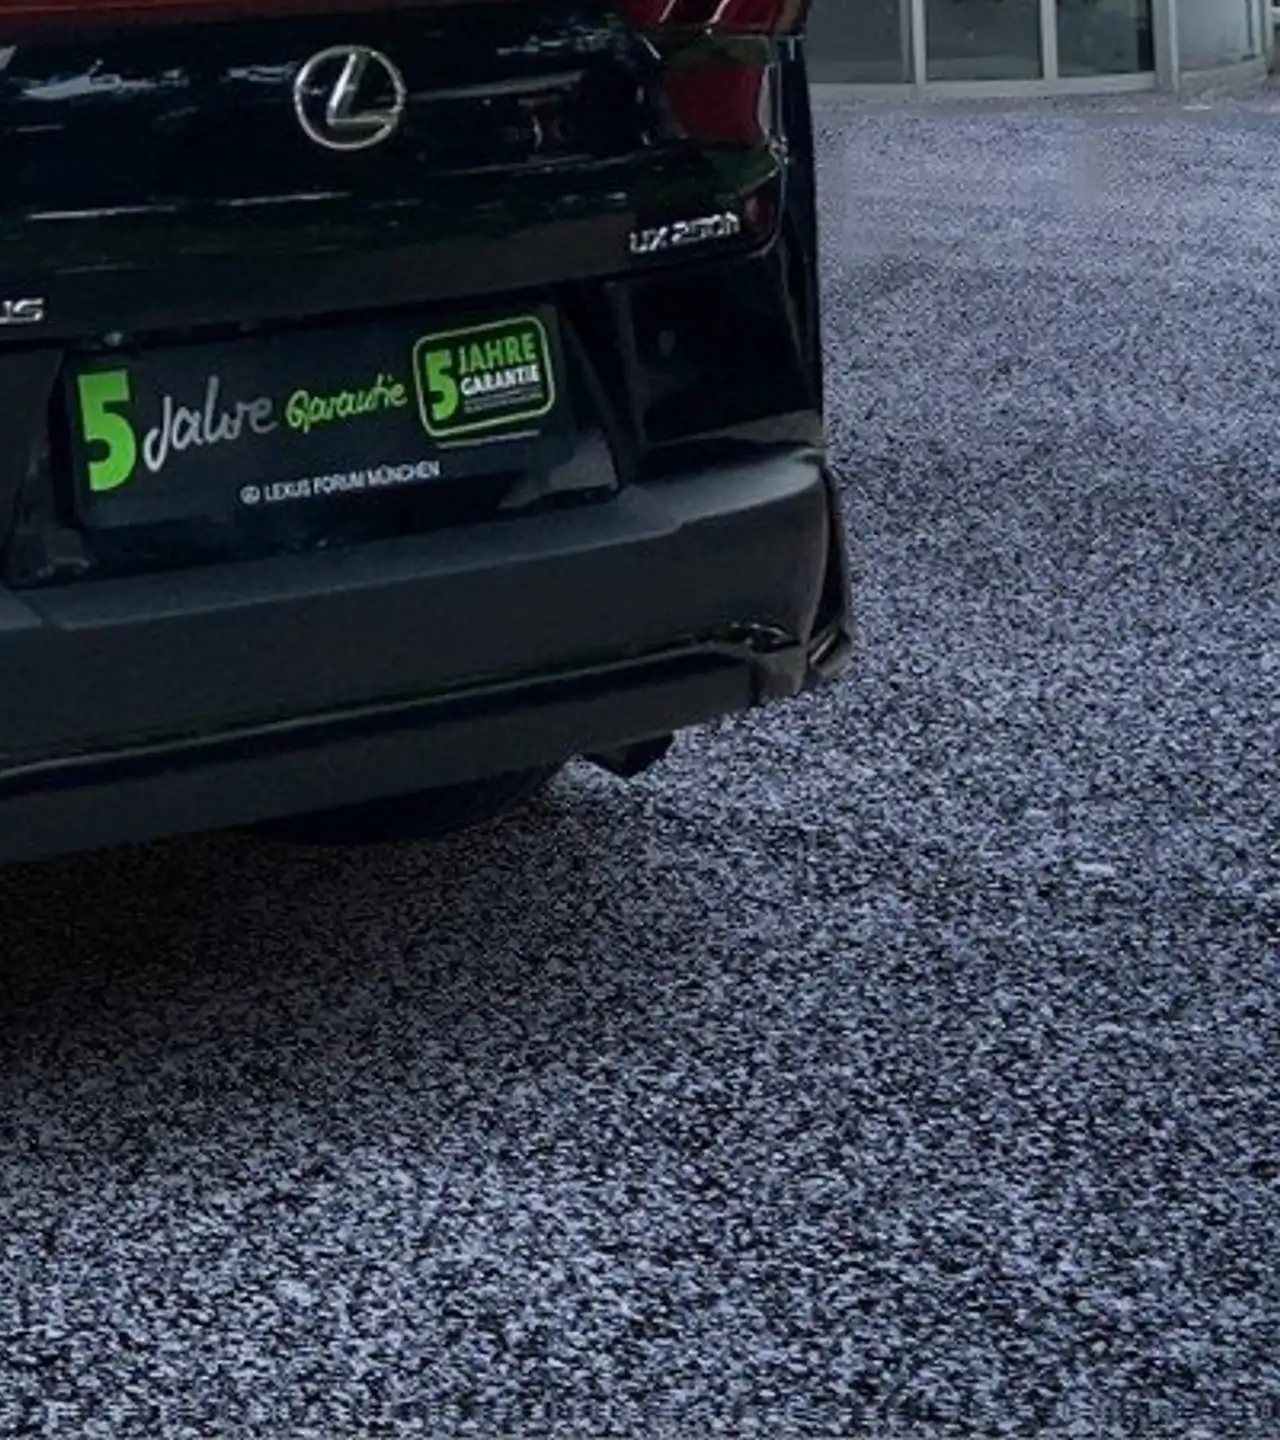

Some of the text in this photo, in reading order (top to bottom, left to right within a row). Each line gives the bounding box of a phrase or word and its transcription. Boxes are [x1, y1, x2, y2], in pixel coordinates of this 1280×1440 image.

[457, 332, 538, 376] JAHRE
[425, 348, 459, 421] 5
[460, 363, 540, 396] GARANTIE
[77, 368, 409, 492] 5 Jahre Garantie
[263, 478, 312, 503] LEXUS
[313, 471, 366, 495] FORUM
